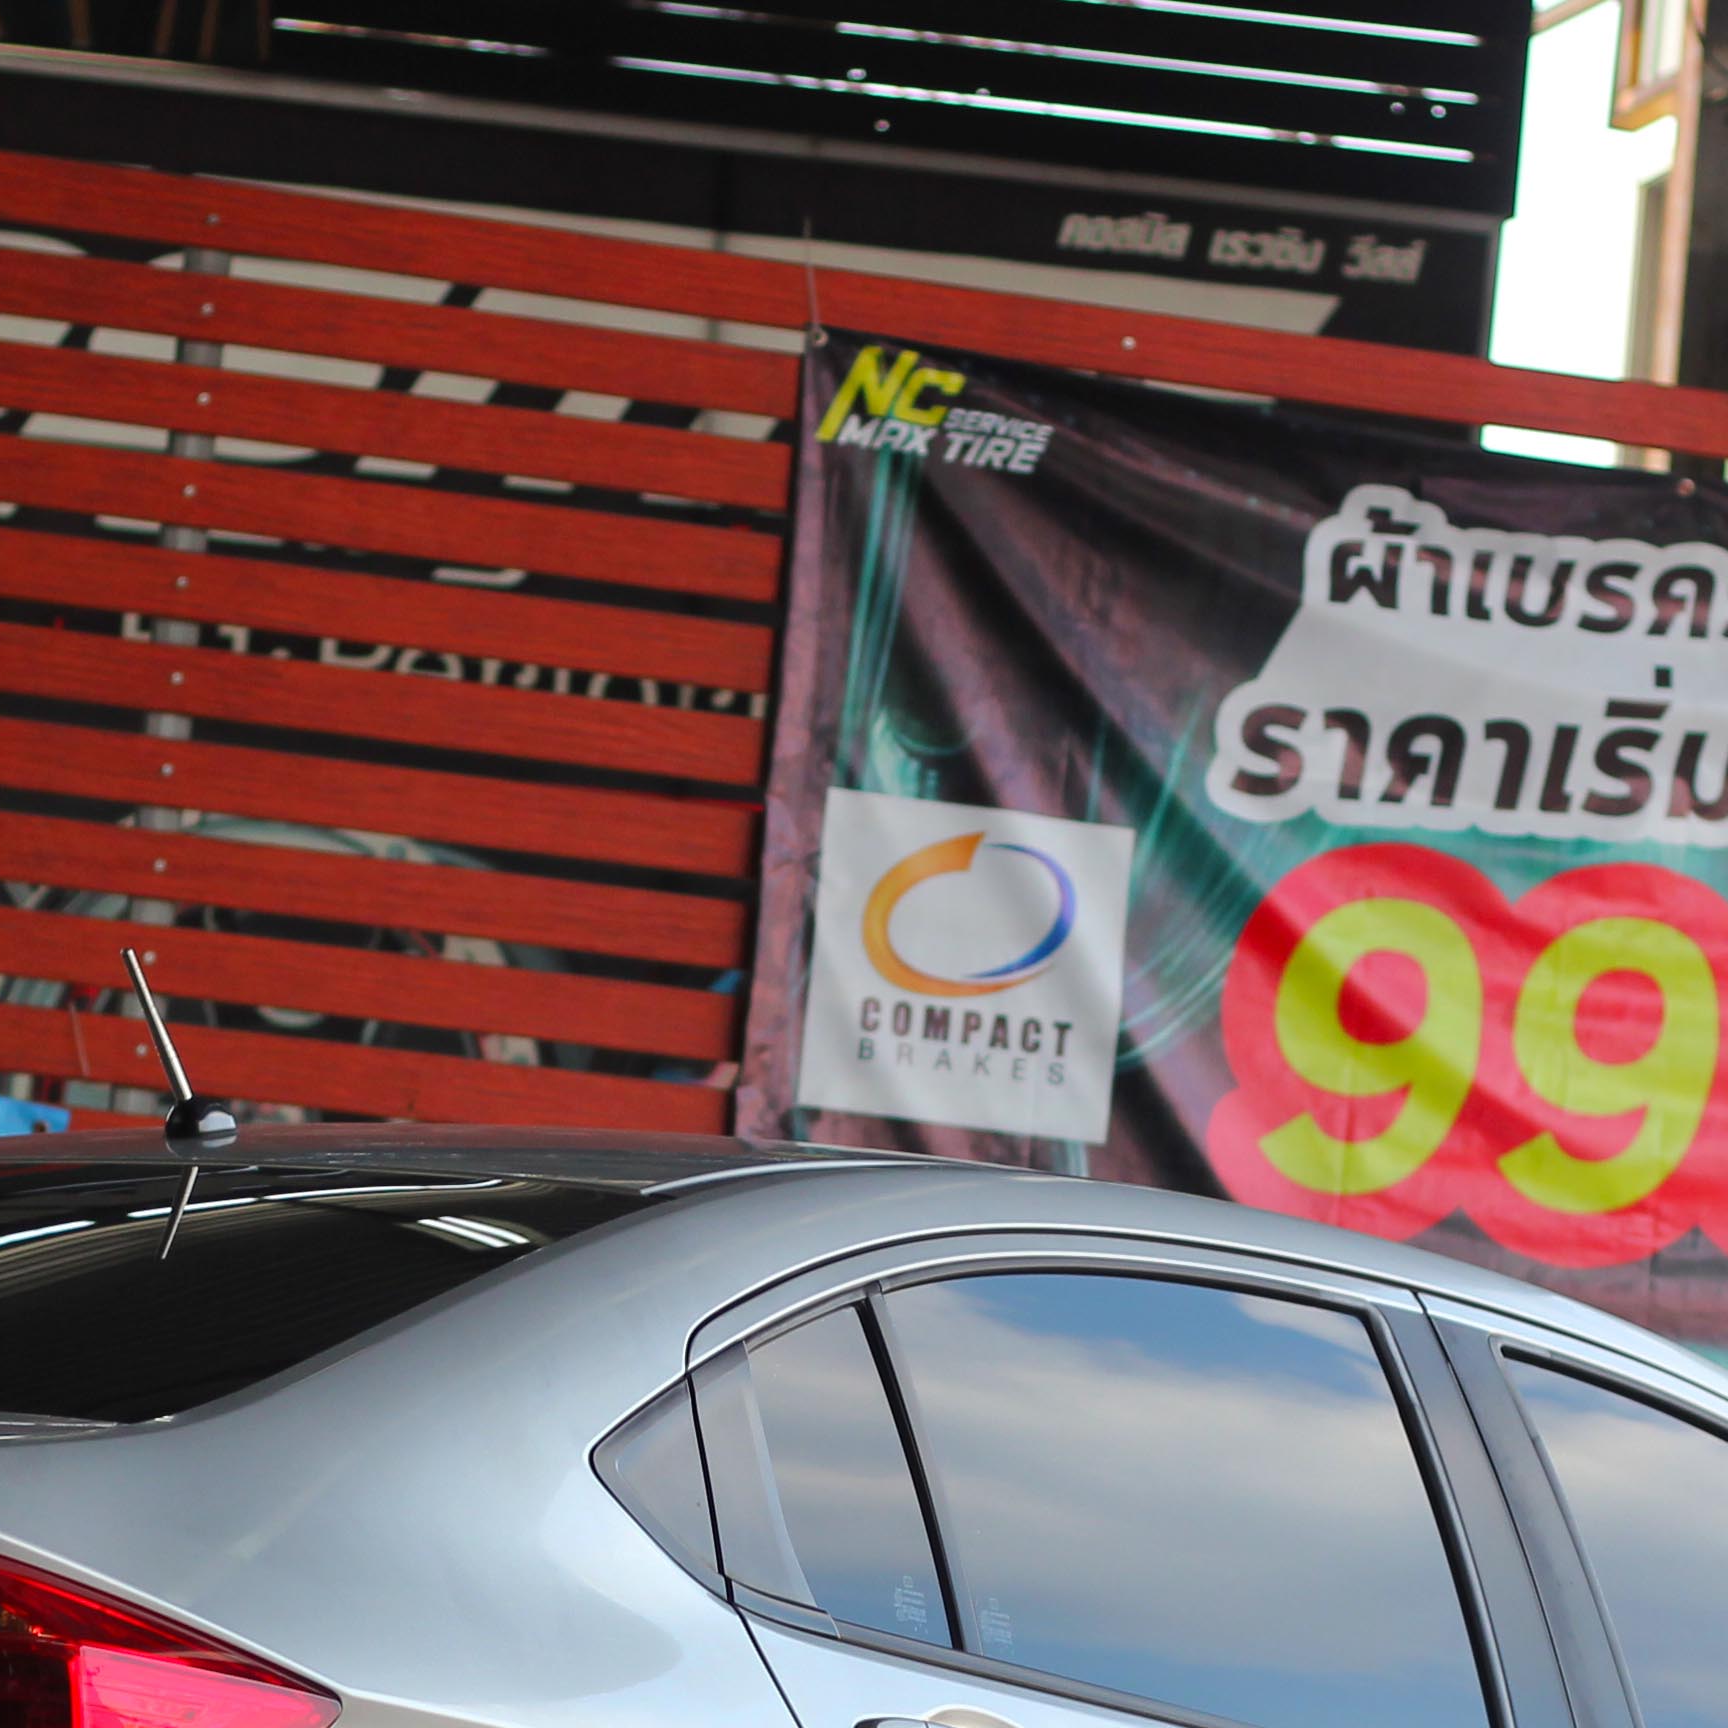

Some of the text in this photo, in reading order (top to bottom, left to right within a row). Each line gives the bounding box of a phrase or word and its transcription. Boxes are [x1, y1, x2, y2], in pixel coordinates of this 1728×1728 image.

[815, 345, 1055, 443] NC SERVICE
[837, 414, 1050, 475] MAX TIRE
[859, 997, 1073, 1057] COMPACT
[857, 1037, 1066, 1086] BRAKES
